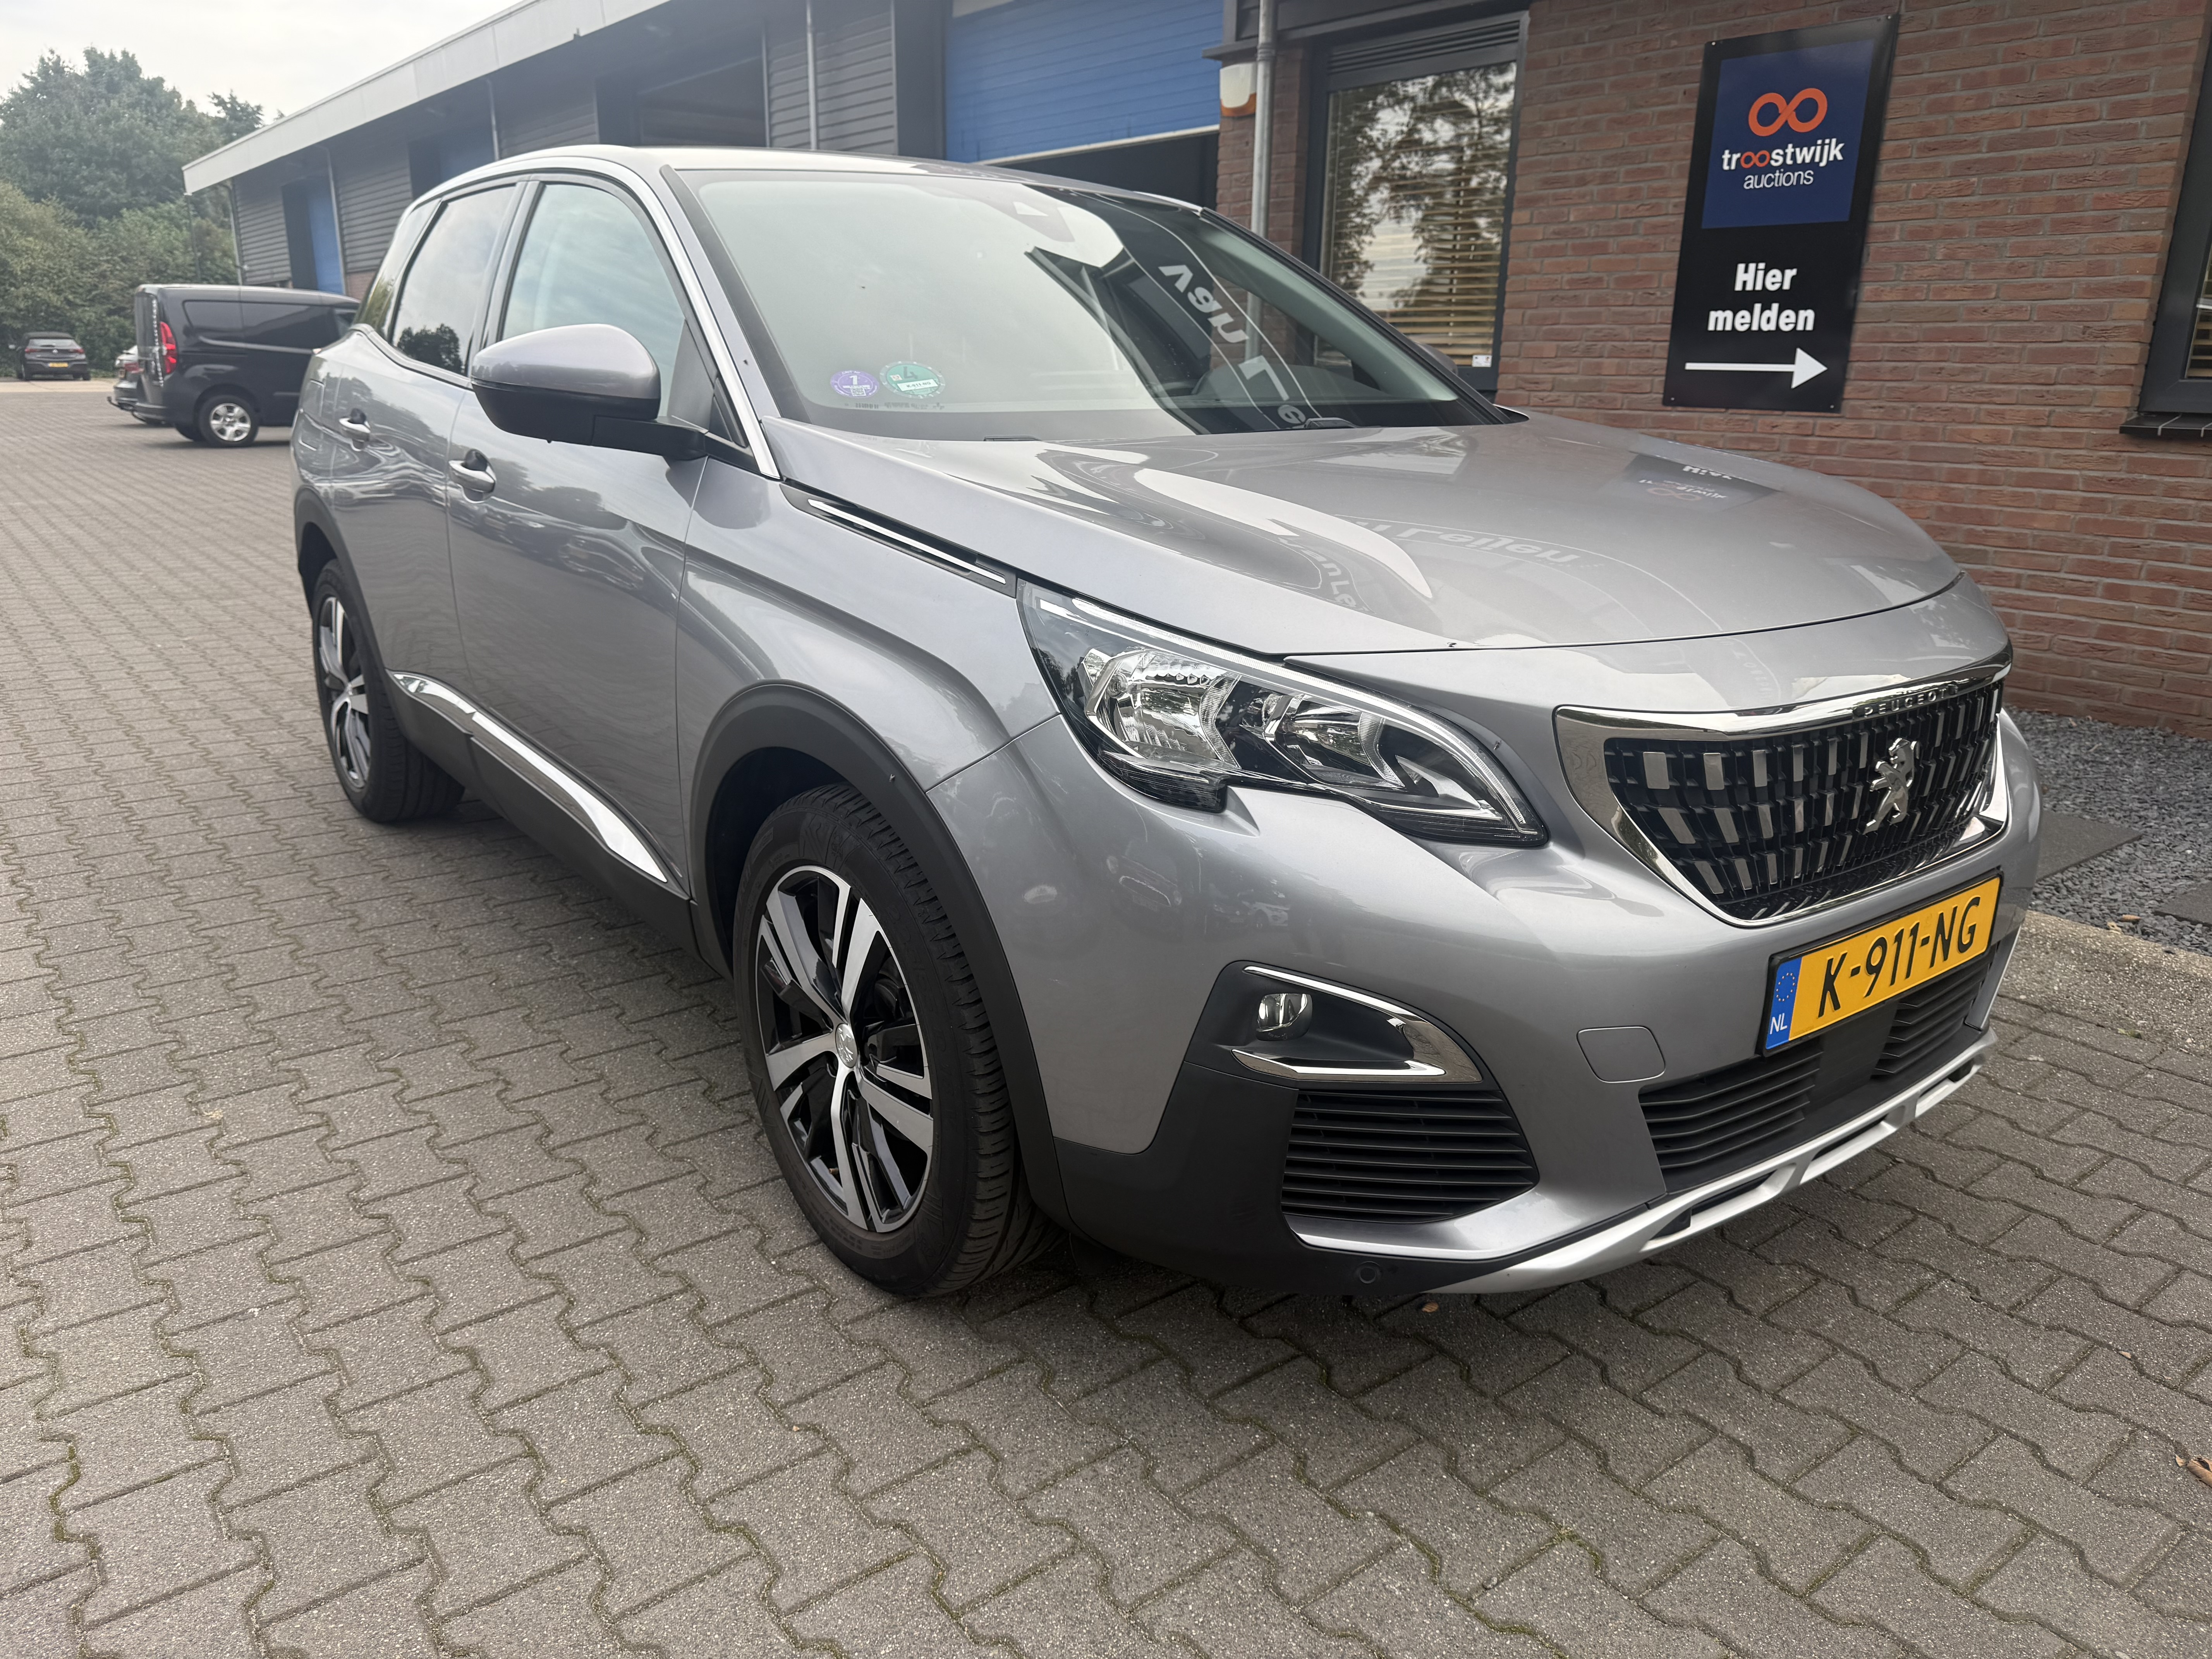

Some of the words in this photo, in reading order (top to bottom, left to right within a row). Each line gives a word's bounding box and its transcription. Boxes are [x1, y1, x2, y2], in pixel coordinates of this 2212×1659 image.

[1722, 138, 1845, 171] troostwijk
[1743, 169, 1814, 189] auctions
[1734, 262, 1797, 291] Hier
[1707, 302, 1815, 332] melden
[849, 375, 859, 385] 1
[903, 366, 918, 380] 4
[1864, 688, 1947, 718] PEUGEOT
[1818, 896, 1980, 1018] K-911-NG
[1769, 1013, 1788, 1035] NL
